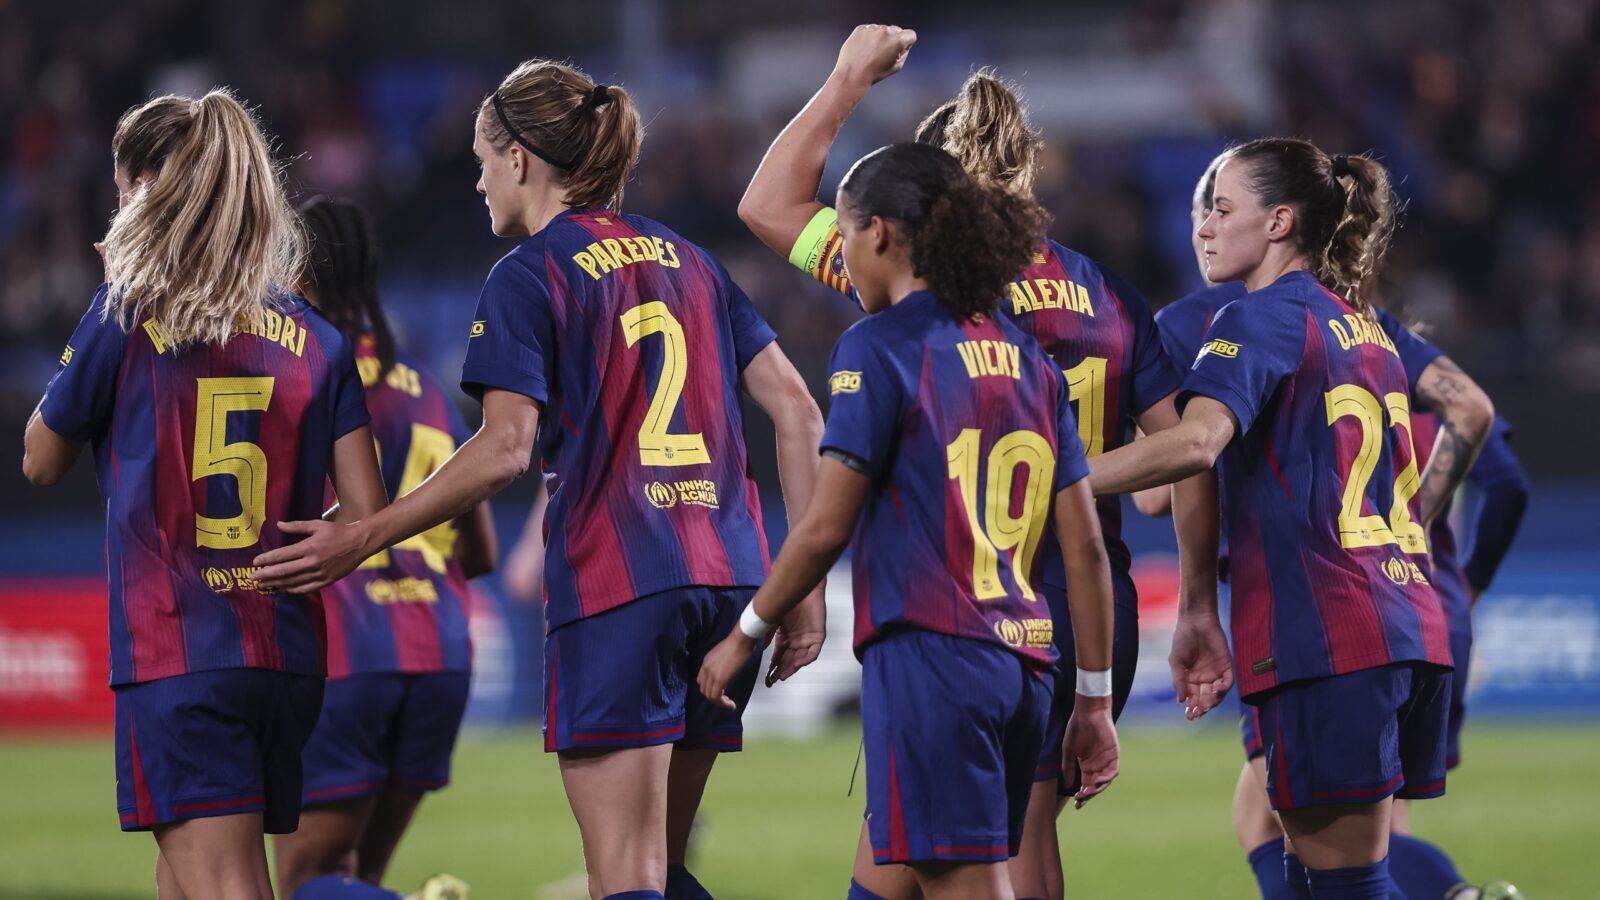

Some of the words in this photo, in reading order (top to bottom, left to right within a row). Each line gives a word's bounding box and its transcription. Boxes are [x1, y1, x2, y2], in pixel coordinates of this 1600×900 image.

[572, 236, 680, 280] PAREDES
[1008, 279, 1094, 317] ALEXIA
[956, 339, 1021, 380] VICKY
[620, 300, 711, 466] 2
[192, 376, 275, 549] 5
[1324, 384, 1428, 554] 22
[674, 480, 715, 493] UNHCR
[681, 490, 718, 505] ACNUR
[946, 428, 1056, 602] 19
[1022, 618, 1053, 631] UNHCR
